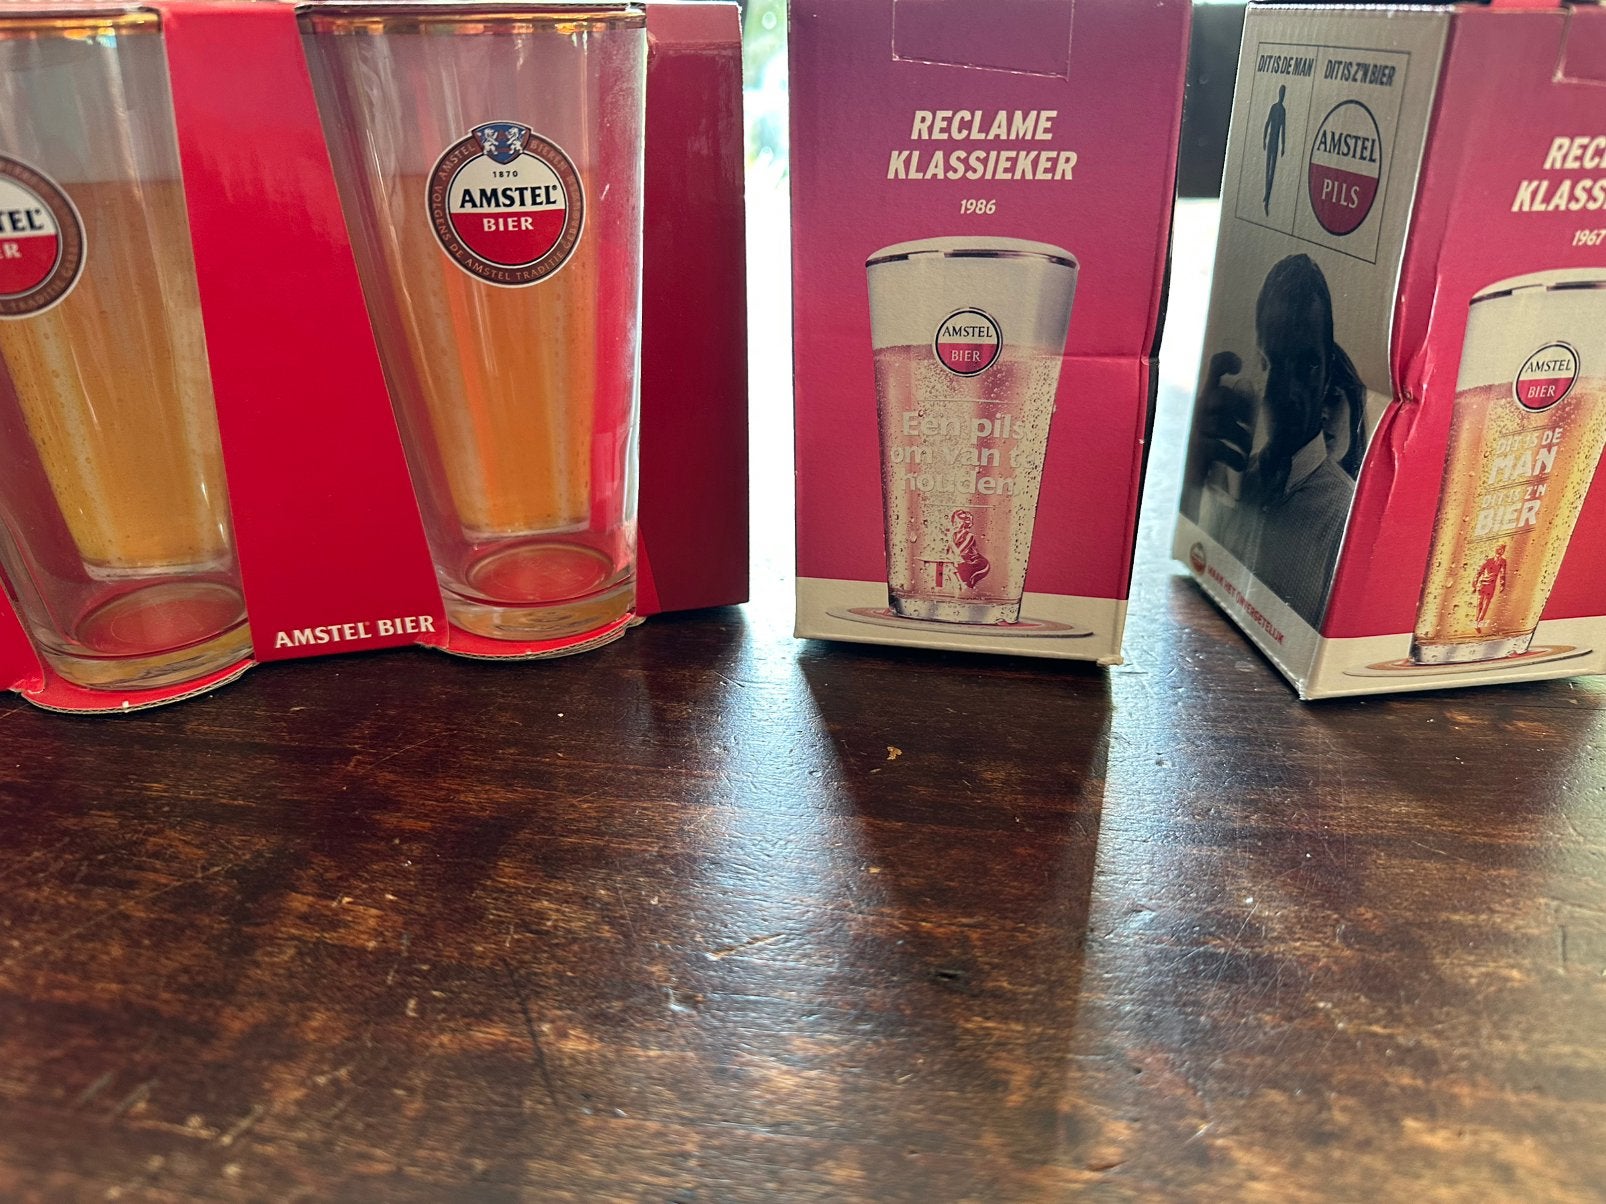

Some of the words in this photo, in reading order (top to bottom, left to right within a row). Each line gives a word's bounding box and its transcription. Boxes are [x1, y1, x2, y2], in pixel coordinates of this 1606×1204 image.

[1258, 55, 1273, 72] DIT
[1271, 56, 1281, 73] IS
[1281, 57, 1294, 75] DE
[1293, 57, 1314, 77] MAN
[1324, 60, 1343, 80] DIT
[1340, 62, 1353, 82] IS
[1369, 64, 1396, 86] BIER
[910, 110, 1058, 140] RECLAME
[1317, 129, 1376, 163] AMSTEL
[438, 142, 476, 180] AMSTEL
[887, 150, 1078, 180] KLASSIEKER
[492, 170, 518, 178] 1870
[1322, 178, 1360, 209] PILS
[1511, 178, 1606, 212] KLASS
[960, 199, 996, 214] 1986
[433, 185, 451, 241] VOLGENS
[450, 243, 463, 258] DE
[465, 258, 511, 281] AMSTEL
[516, 252, 563, 280] TRADITIE
[482, 217, 534, 232] BIER
[1572, 229, 1606, 246] 1967
[943, 326, 993, 339] AMSTEL
[951, 350, 981, 363] BIER
[1525, 359, 1571, 373] AMSTEL
[1528, 384, 1555, 398] BIER
[903, 411, 961, 437] Een
[971, 412, 1025, 444] pils
[1496, 436, 1520, 454] DIT
[1541, 428, 1563, 445] DE
[890, 445, 933, 464] om
[945, 447, 1000, 466] van
[1488, 446, 1558, 485] MAN
[1524, 483, 1547, 499] Z'N
[1474, 500, 1541, 536] BIER
[377, 615, 436, 637] BIER
